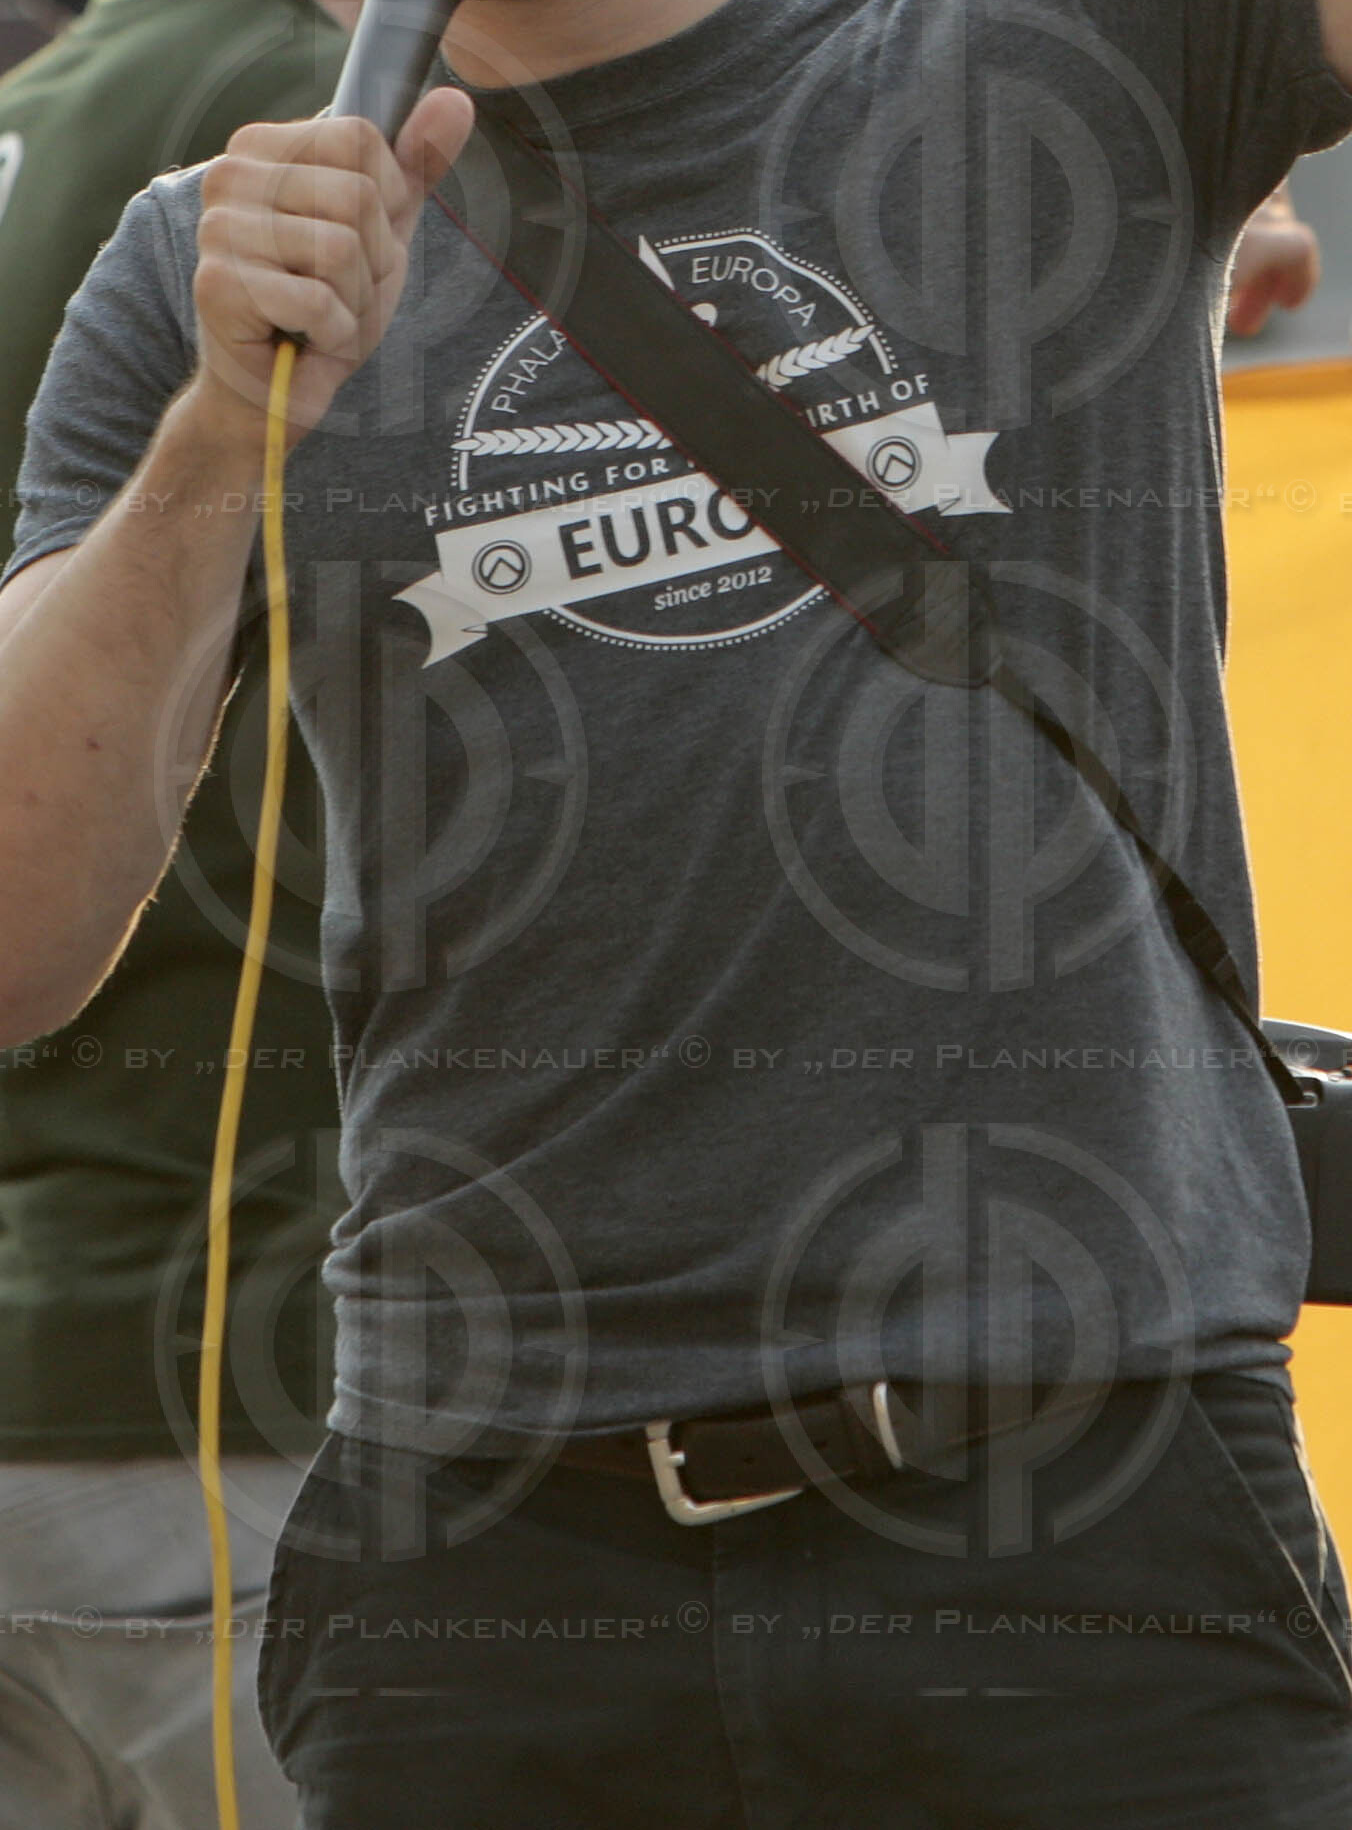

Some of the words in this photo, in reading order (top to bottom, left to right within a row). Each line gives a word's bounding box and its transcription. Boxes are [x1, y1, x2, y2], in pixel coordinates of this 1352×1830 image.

[490, 329, 568, 414] PHALA
[691, 255, 817, 328] EUROPA
[423, 471, 590, 527] FIGHTING
[604, 457, 670, 486] FOR
[799, 390, 881, 428] IRTH
[890, 373, 930, 402] OF
[558, 488, 757, 581] EURO
[654, 580, 713, 612] since
[716, 566, 773, 596] 2012
